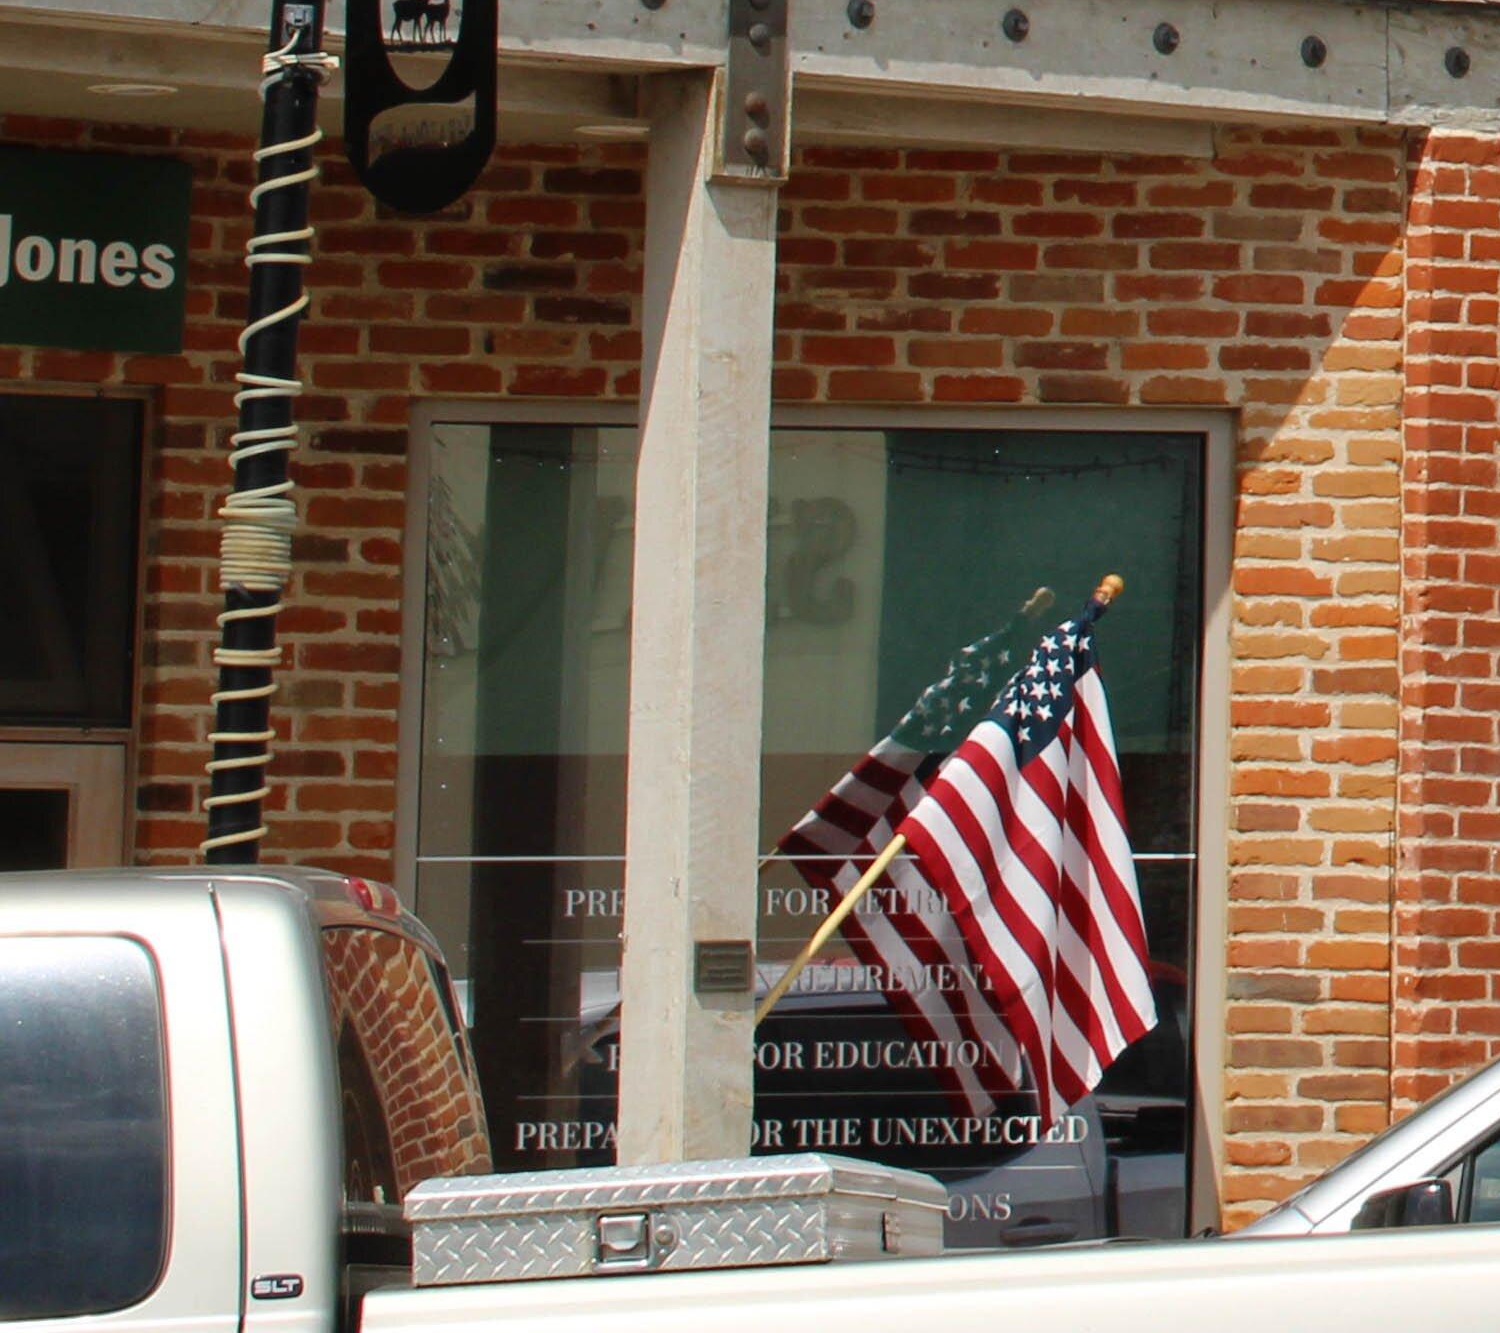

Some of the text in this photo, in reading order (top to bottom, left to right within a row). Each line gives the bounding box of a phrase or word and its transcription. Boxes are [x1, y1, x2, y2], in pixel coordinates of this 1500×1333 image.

[766, 889, 828, 916] FOR
[753, 1040, 998, 1070] OR EDUCATION
[515, 1122, 618, 1150] PREPA
[793, 1118, 864, 1147] THE
[872, 1116, 1089, 1147] UNEXPECTED
[254, 1279, 300, 1294] SLT
